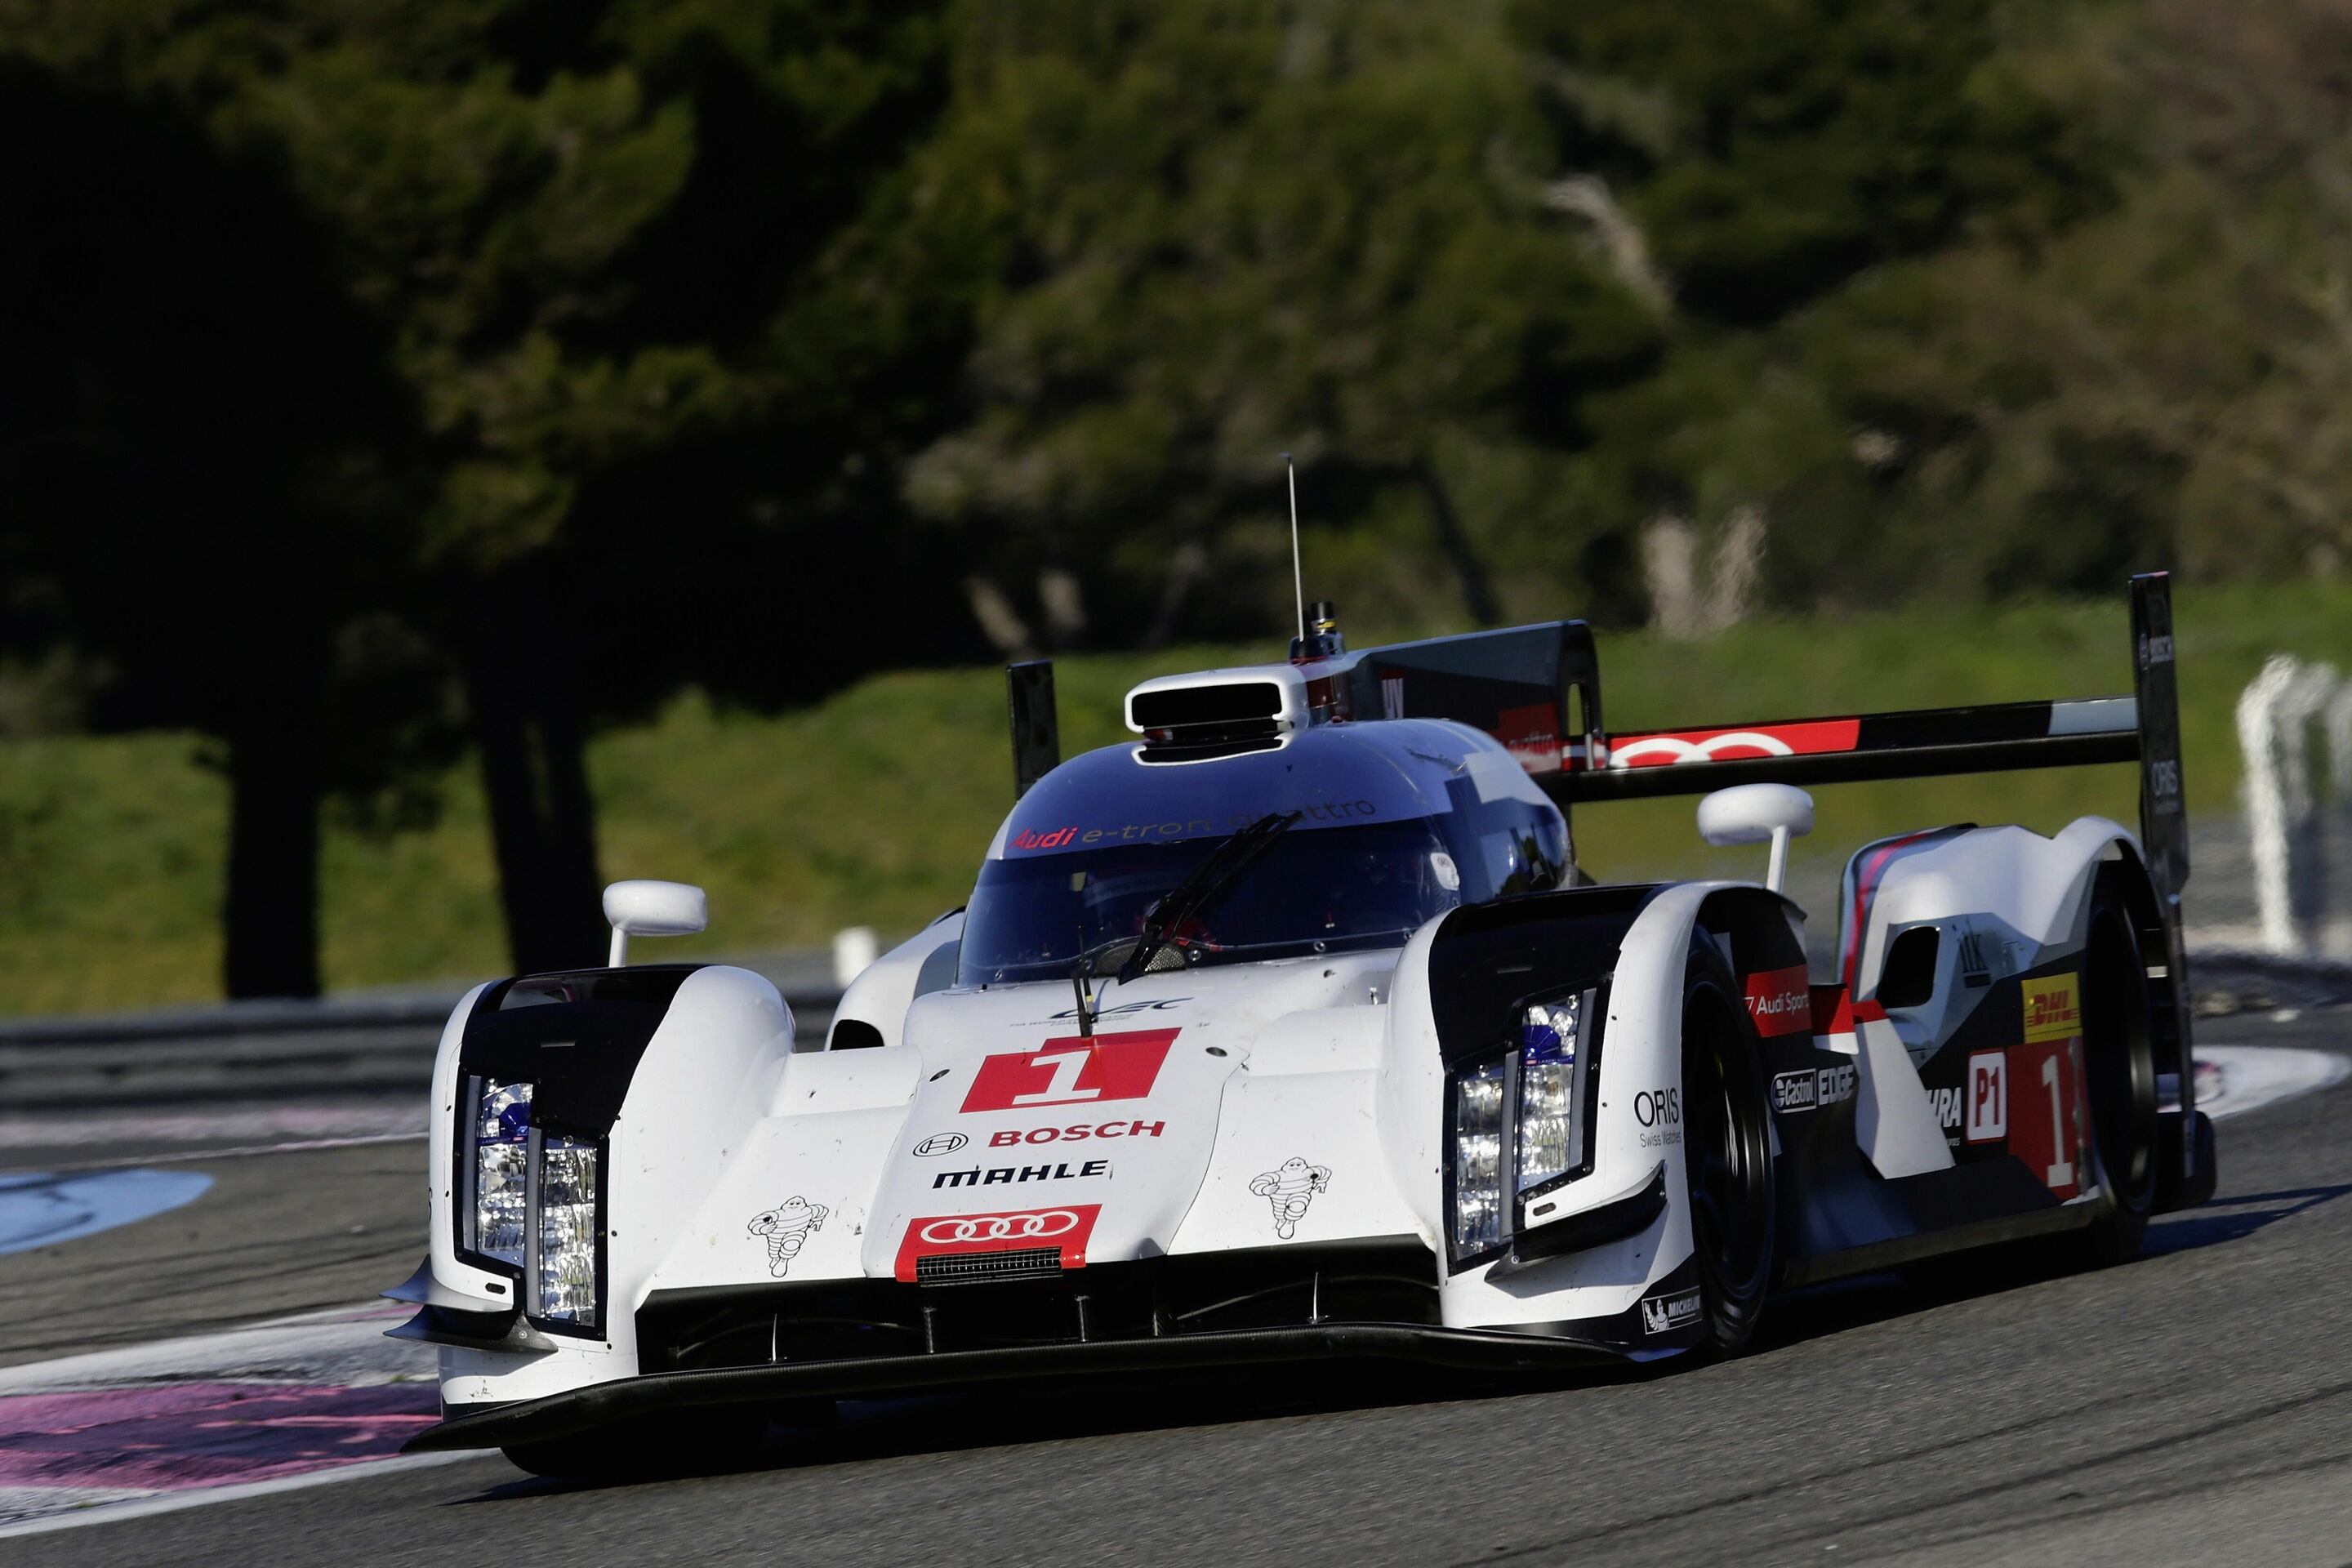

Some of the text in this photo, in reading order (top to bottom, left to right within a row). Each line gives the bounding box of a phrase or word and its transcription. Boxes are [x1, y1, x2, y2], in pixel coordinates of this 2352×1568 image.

[1009, 826, 1078, 850] Audi
[1081, 818, 1211, 845] e-tron
[1756, 991, 1810, 1015] Audi Sport
[2034, 990, 2072, 1026] DHL
[1012, 1050, 1103, 1106] 1
[1784, 1065, 1855, 1107] Castrol EDGE
[1975, 1064, 2000, 1128] P1
[1633, 1087, 1679, 1128] ORIS
[2042, 1054, 2074, 1187] 1
[988, 1120, 1166, 1147] BOSCH
[1639, 1132, 1661, 1148] Swiss
[932, 1160, 1108, 1189] MAHLE
